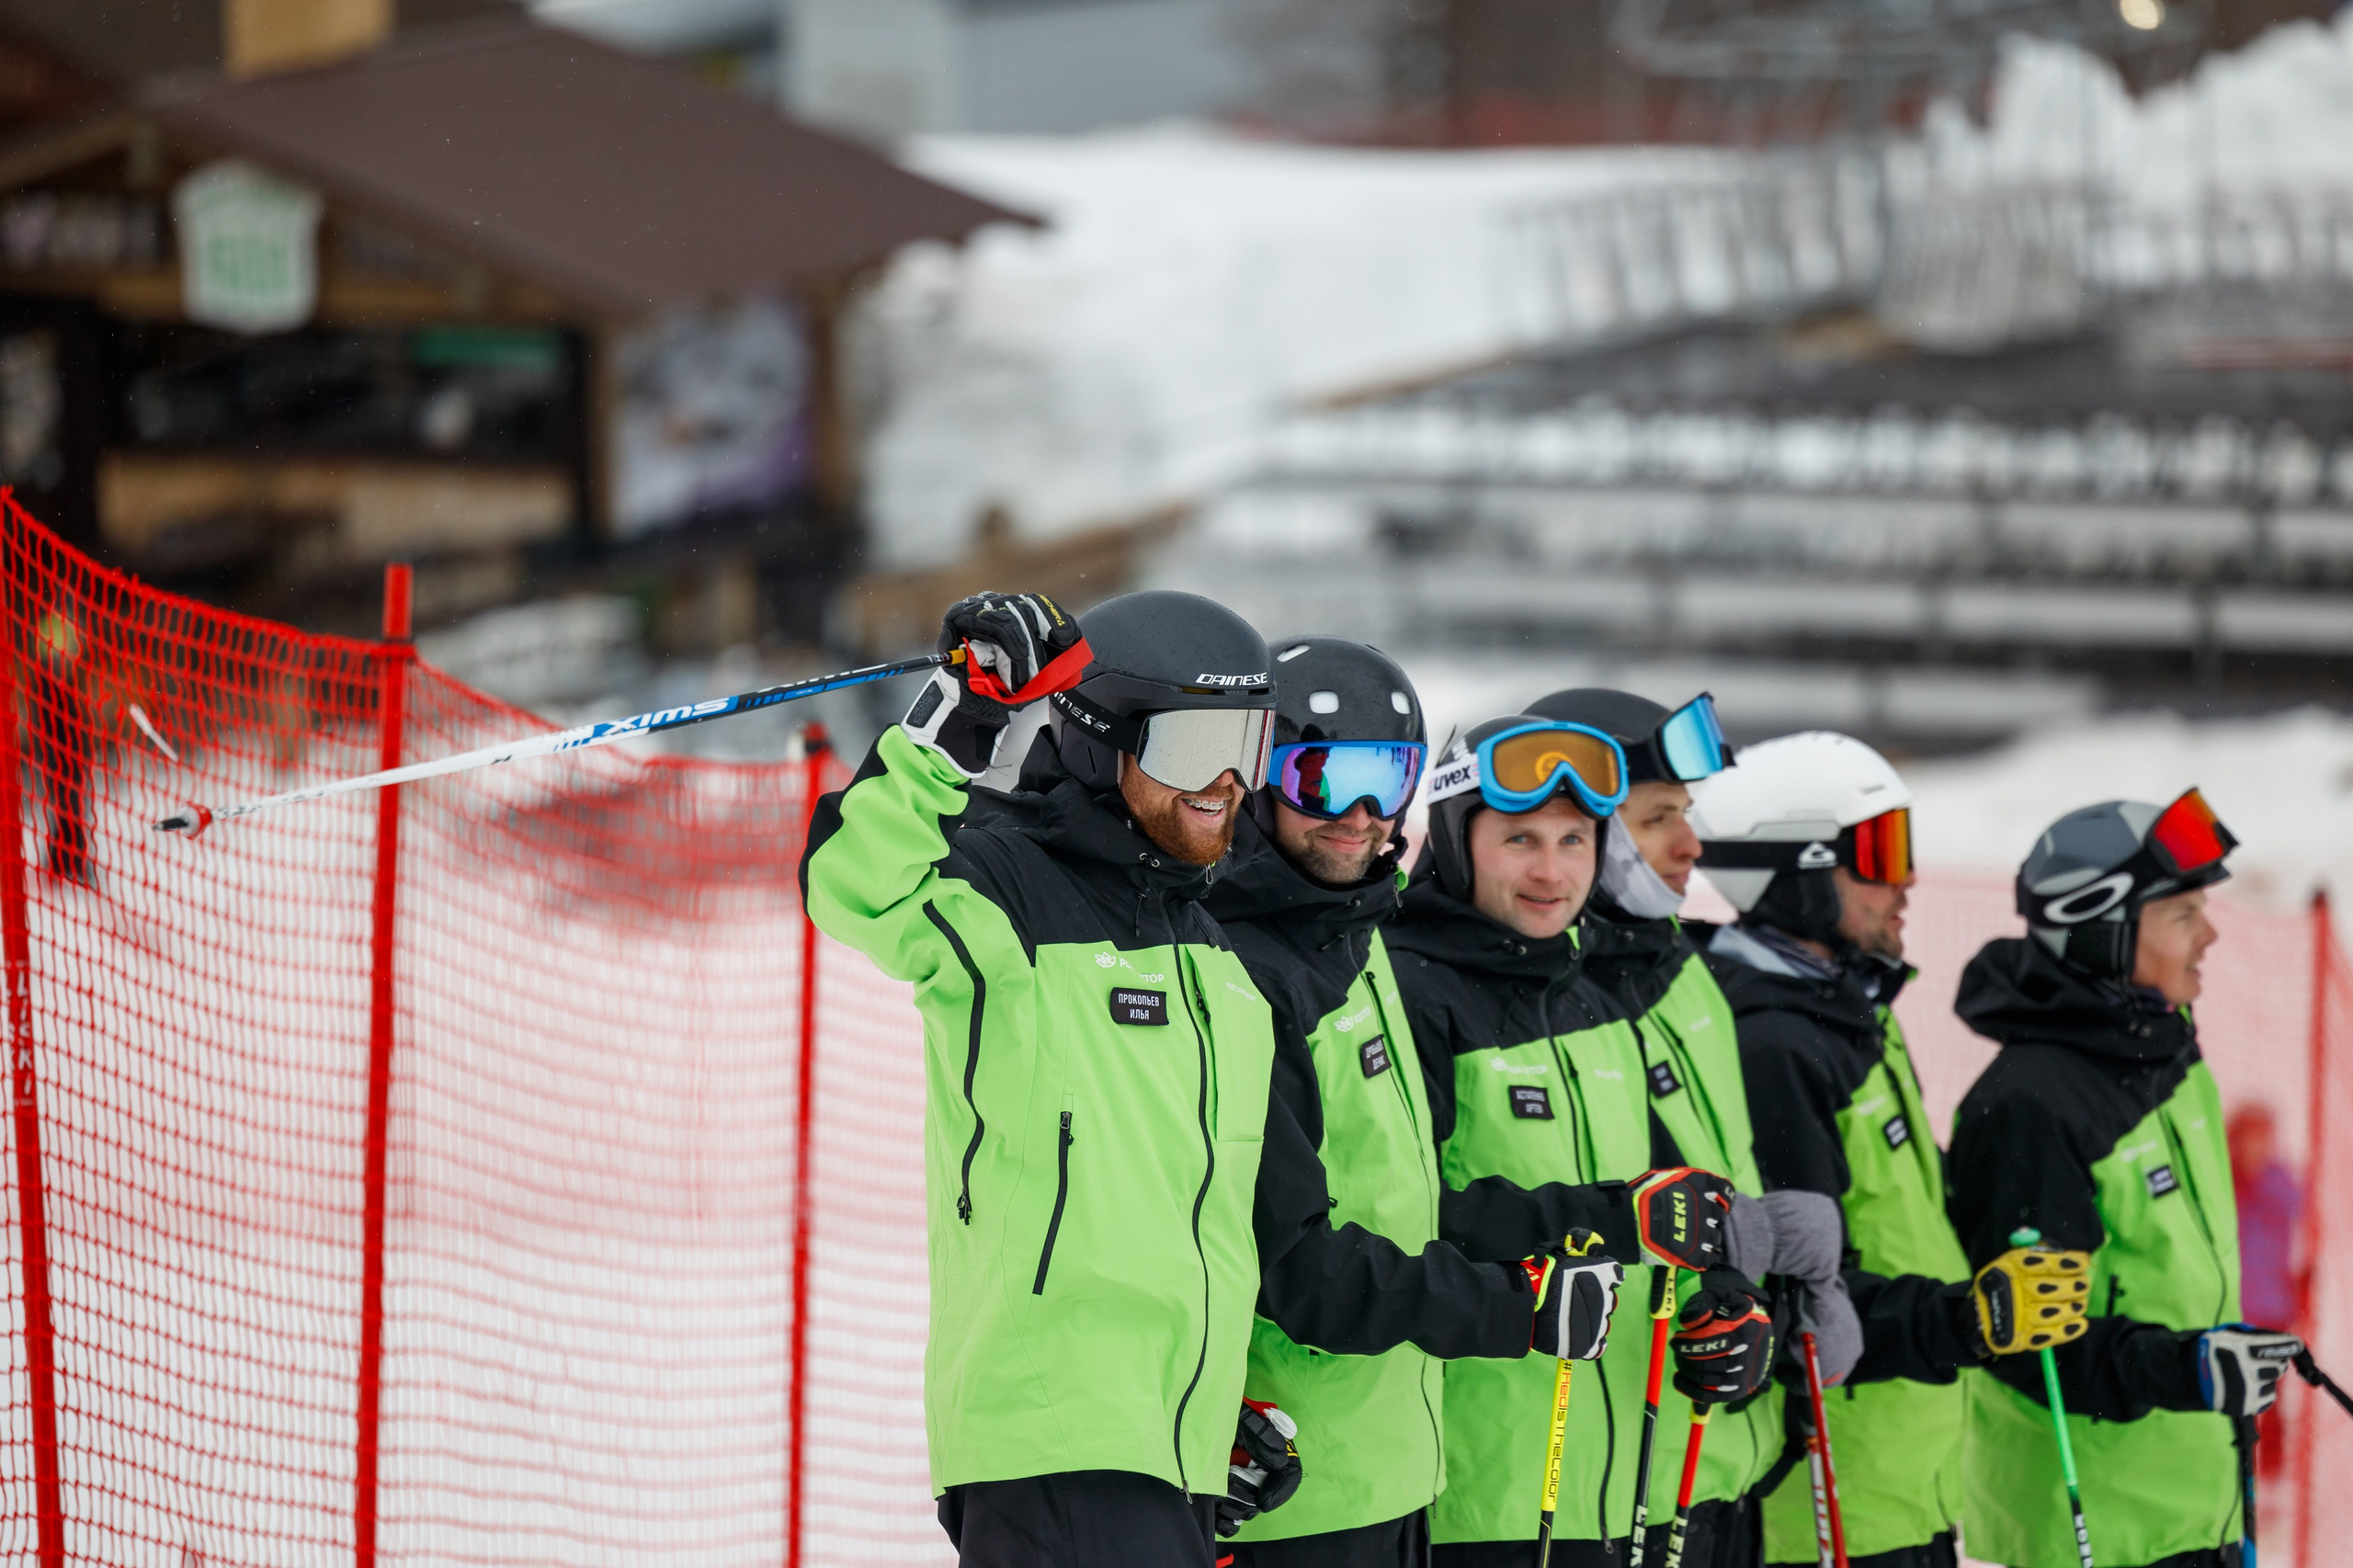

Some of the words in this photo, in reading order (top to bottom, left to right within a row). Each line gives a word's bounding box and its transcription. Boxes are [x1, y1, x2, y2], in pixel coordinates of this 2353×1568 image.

[1195, 672, 1268, 686] DAINESE
[1054, 691, 1110, 733] INESE
[1434, 765, 1472, 790] uvex
[1118, 993, 1160, 1007] ПРОКОПЬЕВ
[1130, 1008, 1150, 1020] ИЛЬЯ
[1672, 1191, 1687, 1243] LEKI
[1665, 1278, 1676, 1312] LEKI
[1680, 1339, 1728, 1353] LEKI
